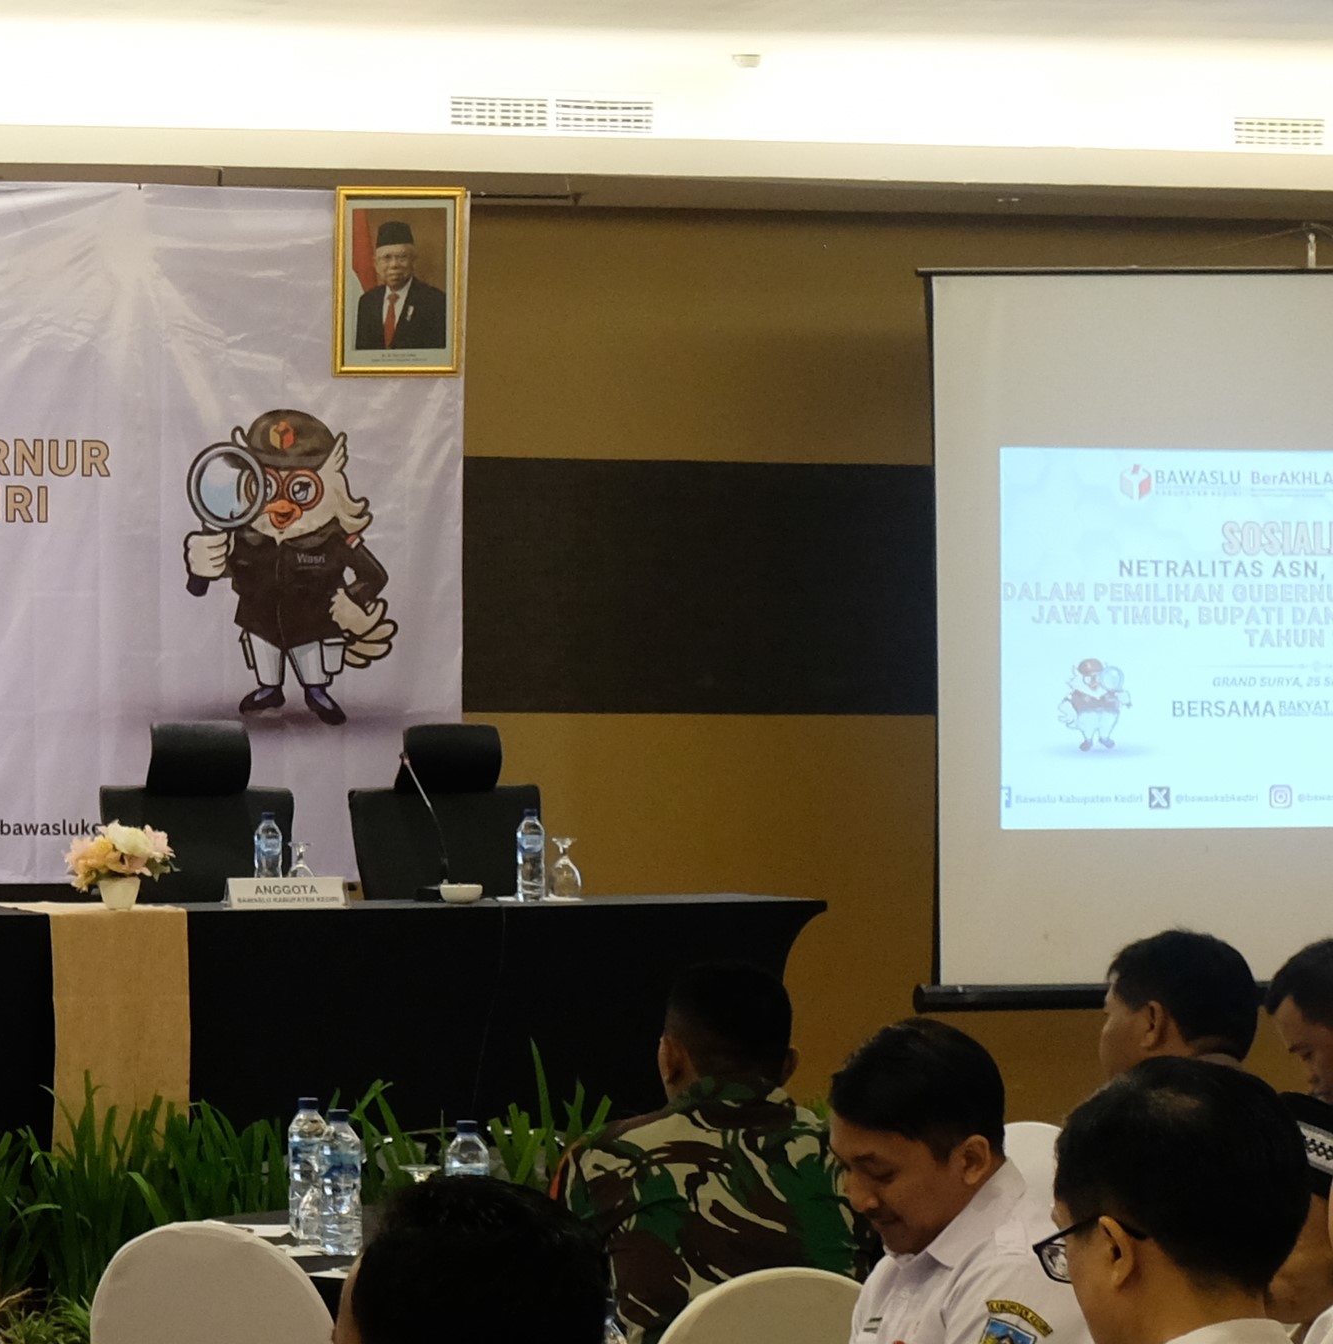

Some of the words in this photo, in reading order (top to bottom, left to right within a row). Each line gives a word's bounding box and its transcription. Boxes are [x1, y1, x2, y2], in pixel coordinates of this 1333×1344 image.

[1154, 469, 1241, 485] BAWASLU
[1119, 560, 1263, 578] NETRALITAS
[1272, 560, 1325, 581] ASN,
[1003, 582, 1085, 603] DALAM
[1094, 583, 1224, 603] PEMILIHAN
[1031, 605, 1101, 625] JAWA
[1107, 605, 1190, 628] TIMUR,
[1198, 606, 1283, 625] BUPATI
[1244, 628, 1325, 648] TAHUN
[1212, 677, 1257, 688] GRAND
[1259, 677, 1303, 689] SURYA,
[1171, 700, 1275, 717] BERSAMA
[1279, 700, 1329, 712] RAKYAT
[1114, 793, 1143, 803] Kediri
[255, 885, 318, 895] ANGGOTA
